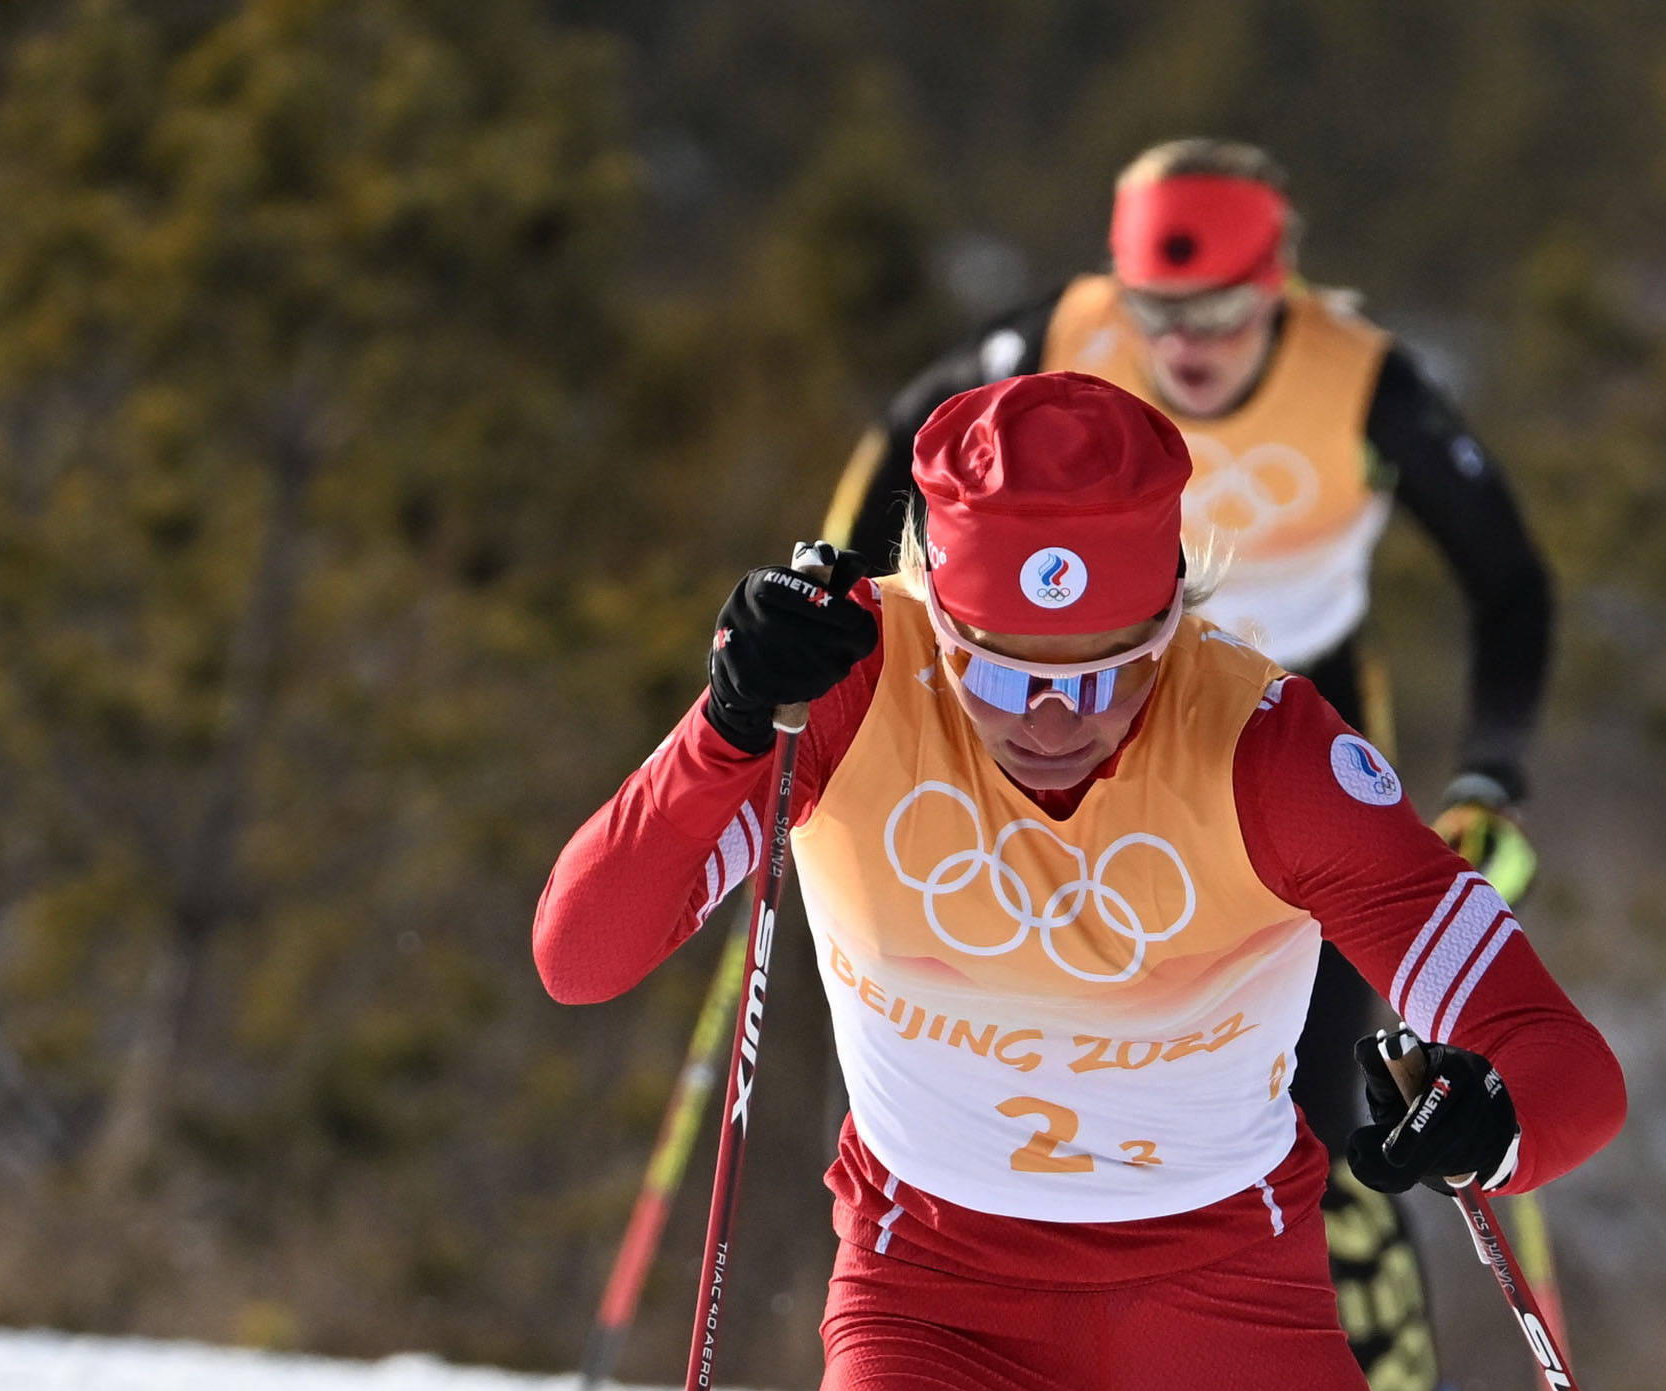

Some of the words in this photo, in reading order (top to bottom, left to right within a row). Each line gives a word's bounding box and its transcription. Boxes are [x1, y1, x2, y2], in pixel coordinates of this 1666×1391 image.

[731, 899, 775, 1140] SWIX
[827, 933, 1044, 1073] BEIJING
[1067, 1011, 1260, 1074] 2022
[994, 1095, 1095, 1173] 2
[712, 1242, 728, 1299] TRIAC
[699, 1332, 715, 1387] AERO
